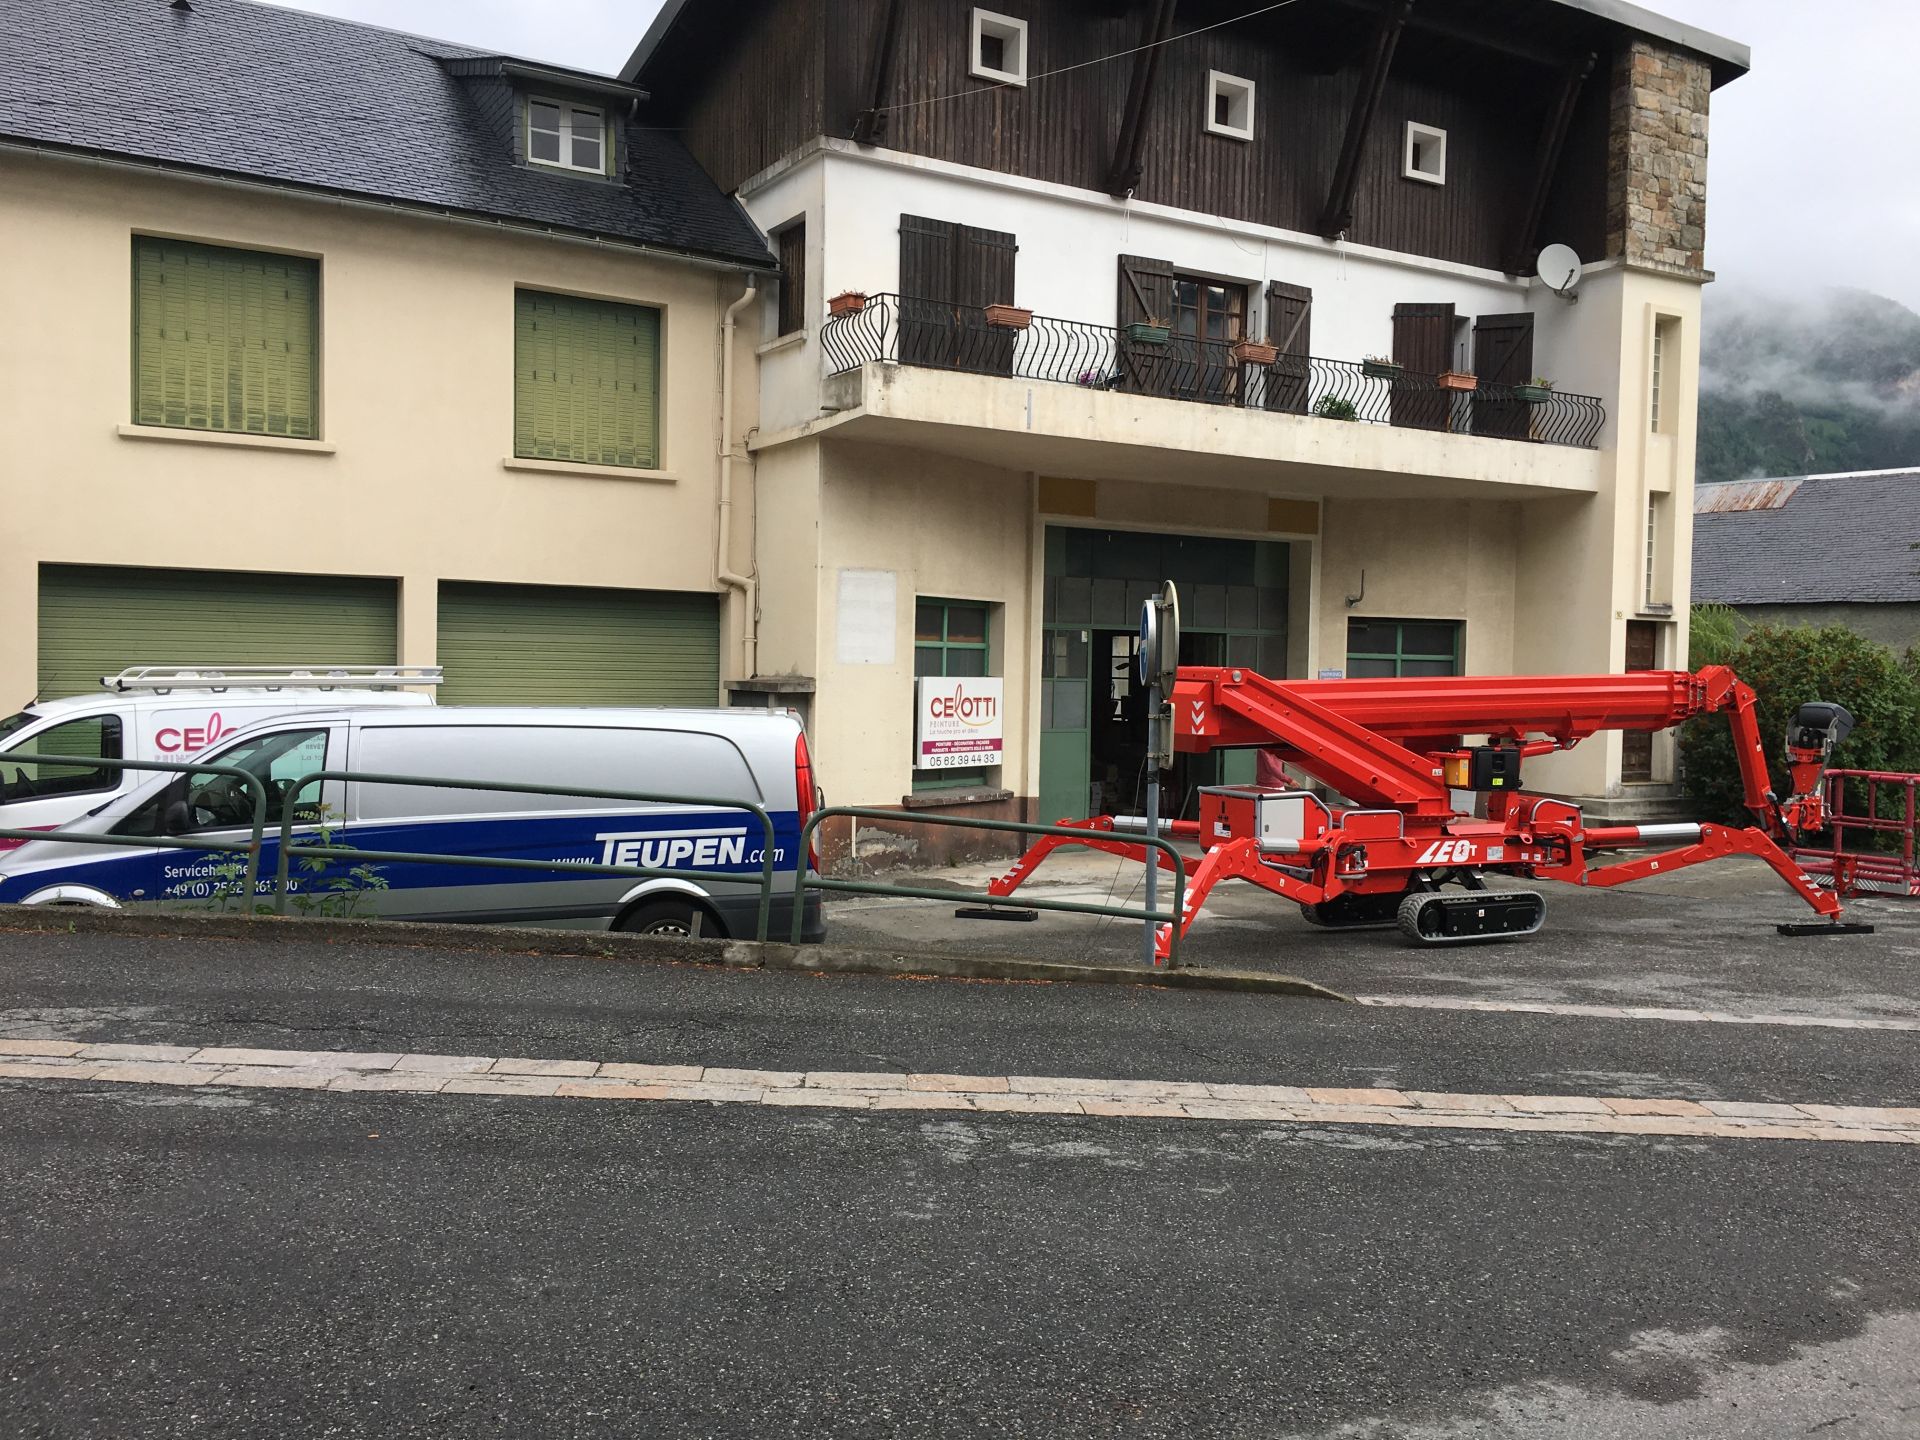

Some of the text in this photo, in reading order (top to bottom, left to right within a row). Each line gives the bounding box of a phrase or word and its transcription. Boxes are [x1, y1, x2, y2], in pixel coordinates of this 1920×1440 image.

[929, 756, 942, 766] 05
[983, 753, 995, 763] 33
[164, 863, 249, 878] Servicehne
[165, 883, 188, 896] +49
[191, 882, 210, 897] (0)
